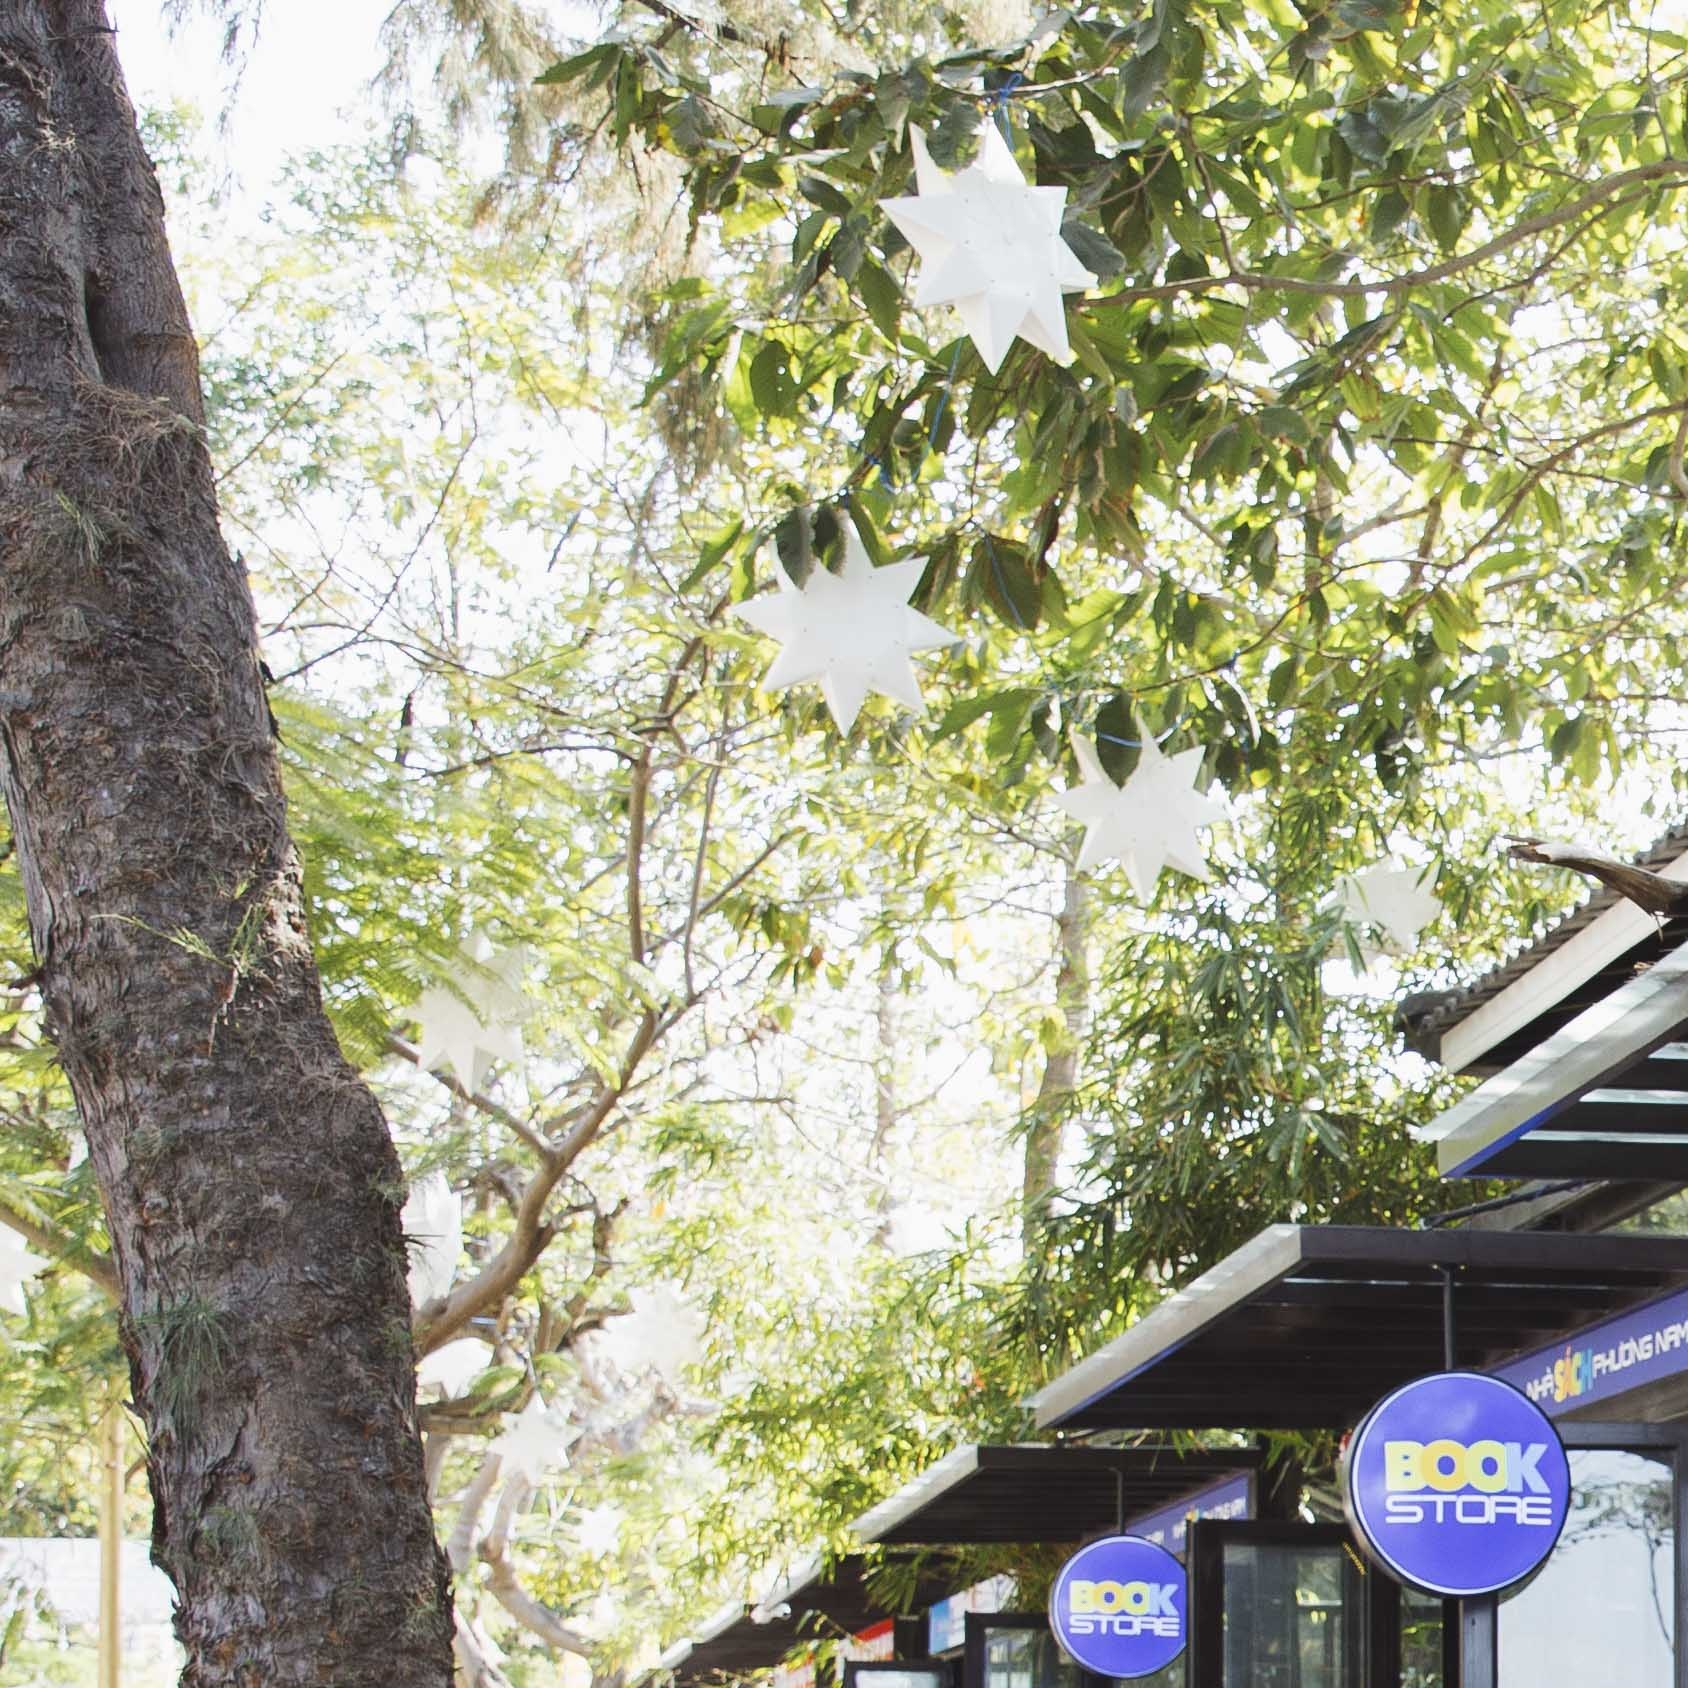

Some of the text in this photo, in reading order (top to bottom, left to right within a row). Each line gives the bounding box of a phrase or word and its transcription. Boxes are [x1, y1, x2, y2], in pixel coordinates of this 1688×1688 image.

[1526, 1366, 1554, 1401] NHÀ
[1553, 1344, 1594, 1402] SÁCH
[1592, 1334, 1654, 1379] PHƯƠNG
[1384, 1439, 1551, 1493] BOOK
[1385, 1494, 1552, 1526] STORE
[1069, 1580, 1179, 1616] BOOK
[1069, 1614, 1180, 1637] STORE
